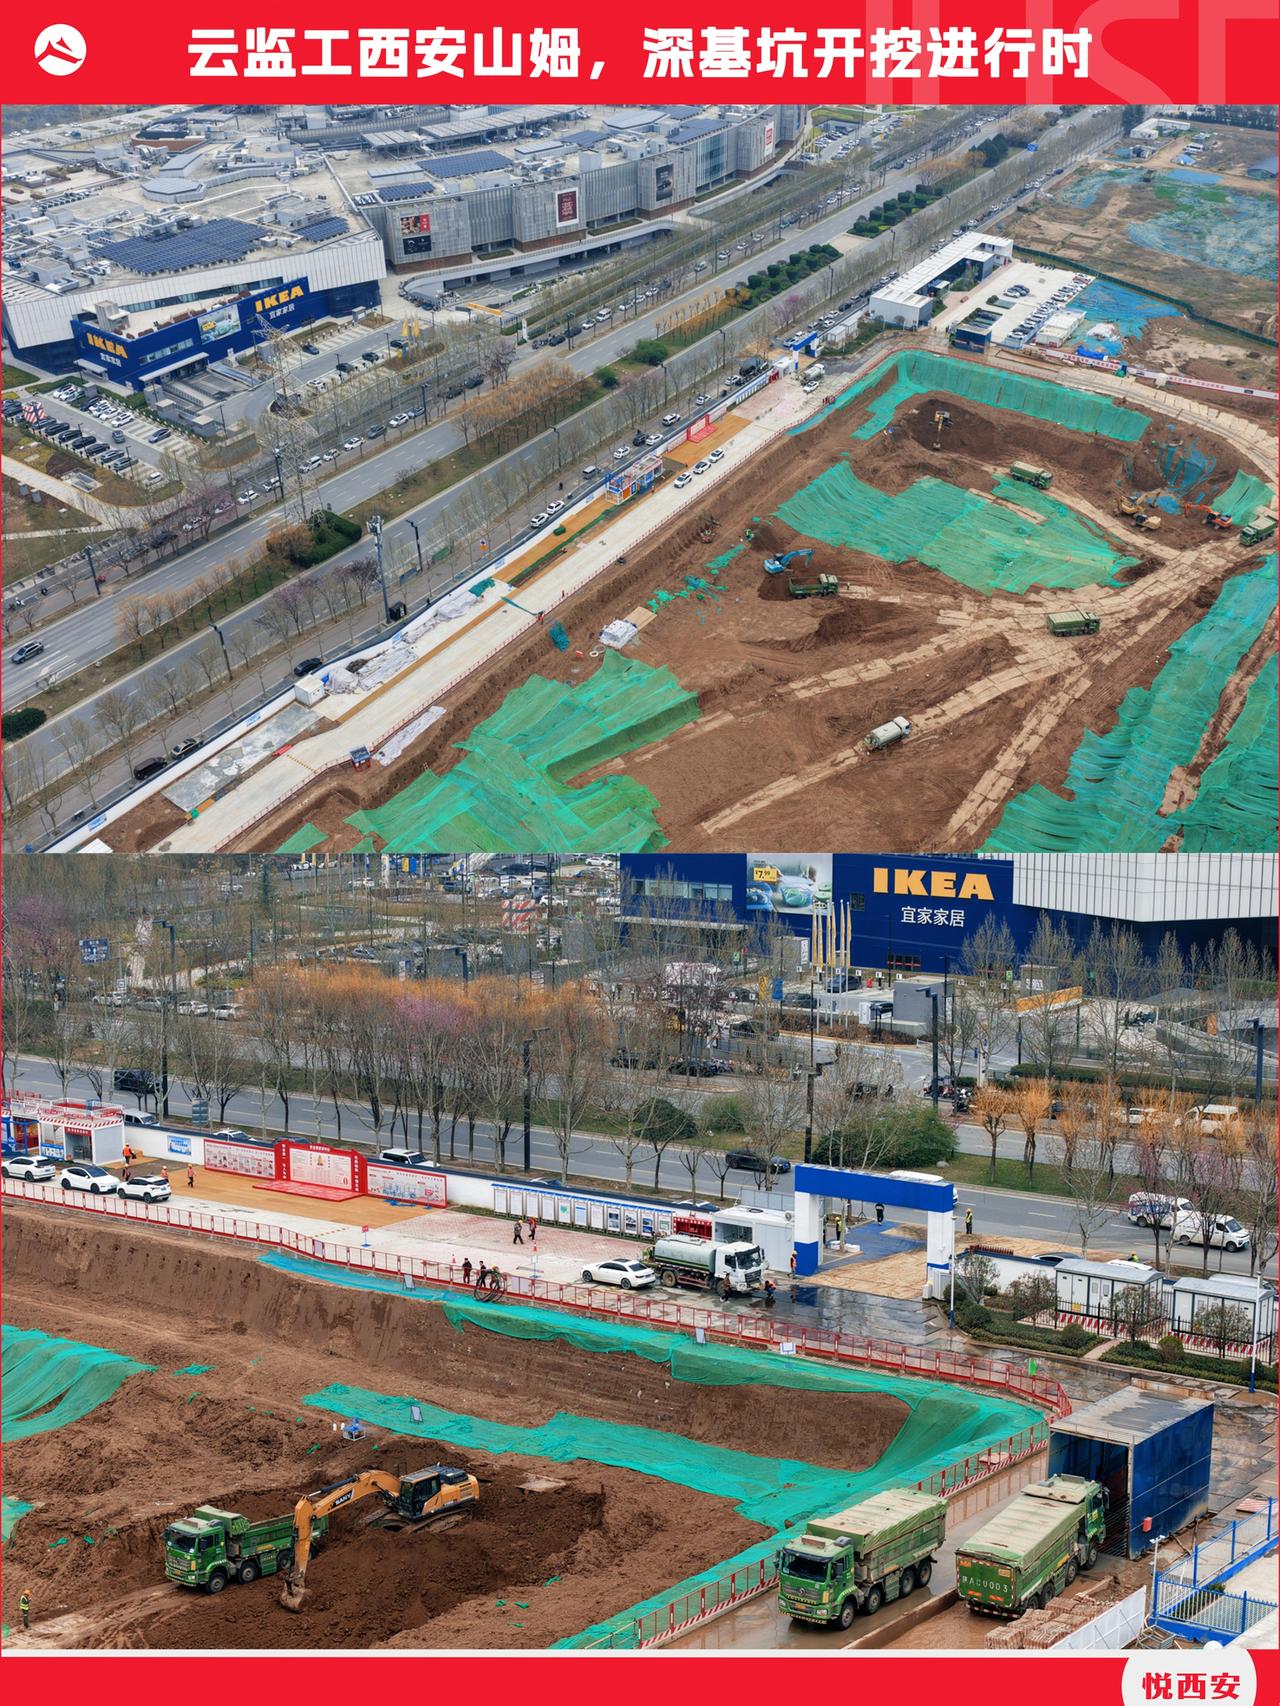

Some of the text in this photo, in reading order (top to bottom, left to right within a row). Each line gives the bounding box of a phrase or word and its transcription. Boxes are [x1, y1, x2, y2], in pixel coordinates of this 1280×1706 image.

[255, 286, 304, 313] IKEA
[87, 333, 129, 359] IKEA
[873, 867, 994, 901] IKEA
[900, 905, 966, 928] 宜家家居
